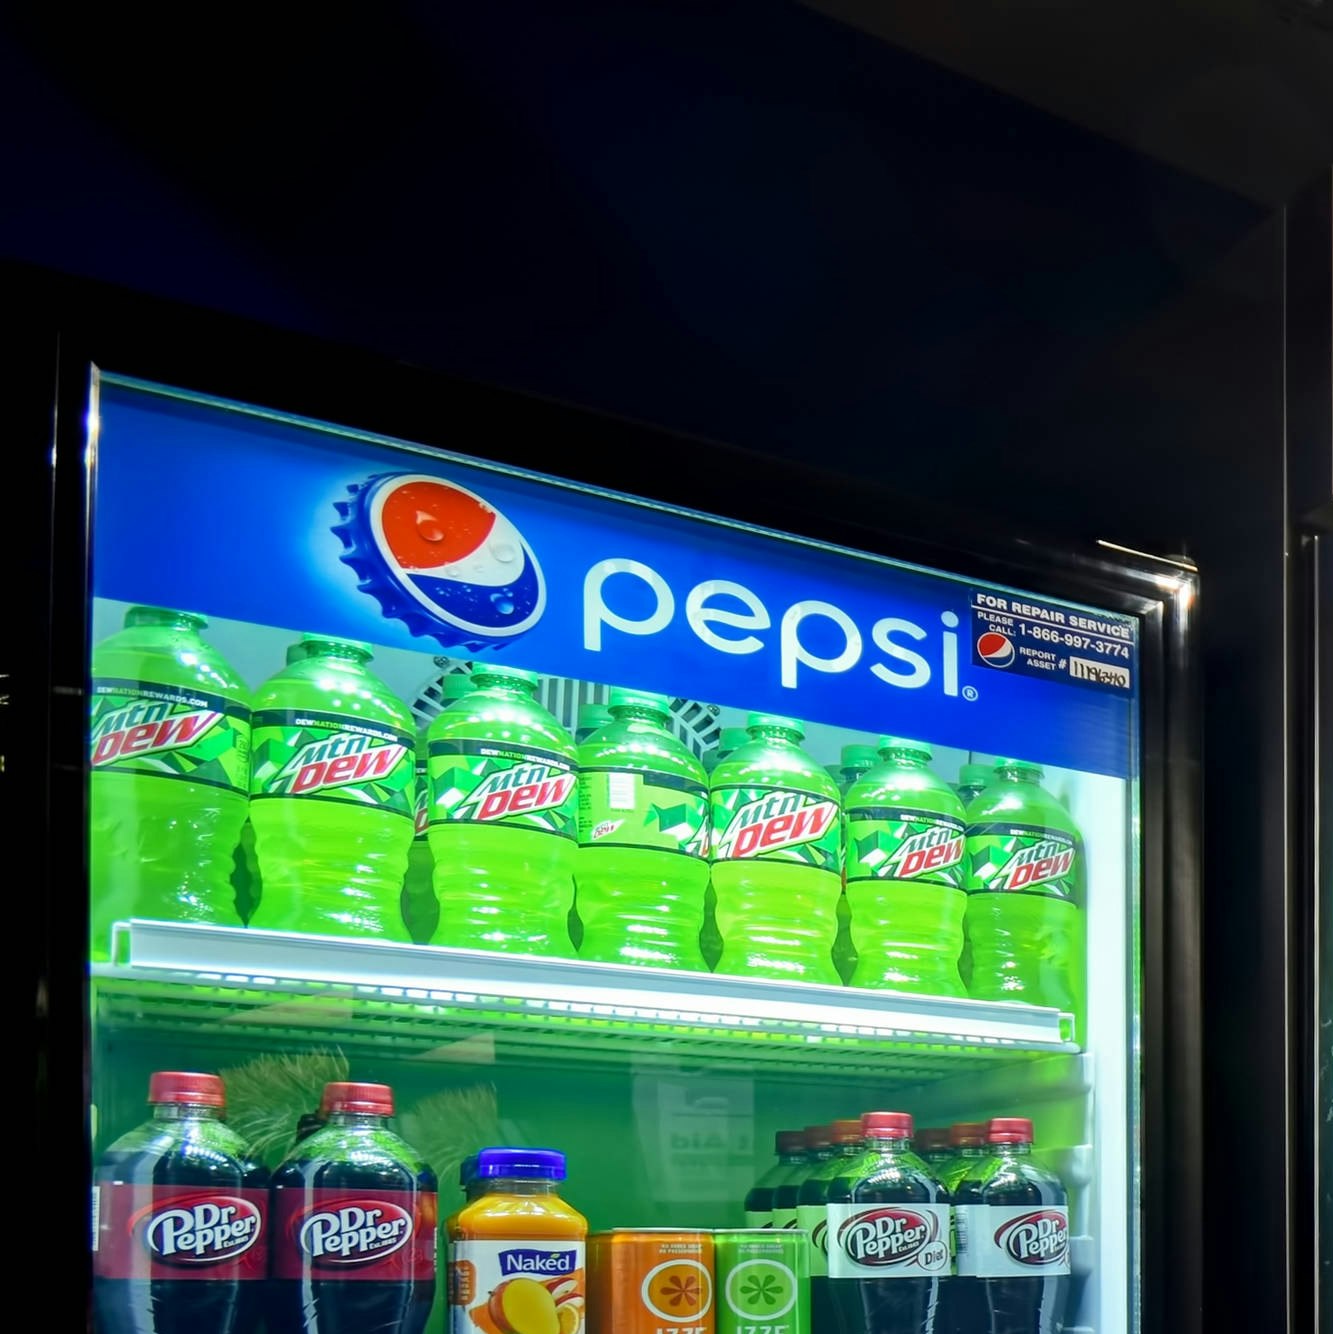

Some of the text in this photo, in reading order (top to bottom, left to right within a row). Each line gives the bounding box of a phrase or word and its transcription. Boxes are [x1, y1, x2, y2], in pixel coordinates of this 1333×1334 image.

[583, 558, 958, 697] pepsi
[977, 593, 1130, 638] FOR REPAIR SERVICE
[978, 612, 1014, 626] PLEASE
[989, 623, 1129, 659] CALL: 1-866-997-3774
[1020, 646, 1056, 661] REPORT
[1027, 658, 1067, 671] ASSET #
[195, 1203, 236, 1231] Dr
[340, 1205, 383, 1232] Dr
[876, 1216, 908, 1239] Dr
[160, 1212, 257, 1257] Pepper
[306, 1214, 407, 1257] Pepper
[856, 1222, 925, 1258] Pepper
[506, 1252, 571, 1272] Naked
[925, 1248, 945, 1264] Diet
